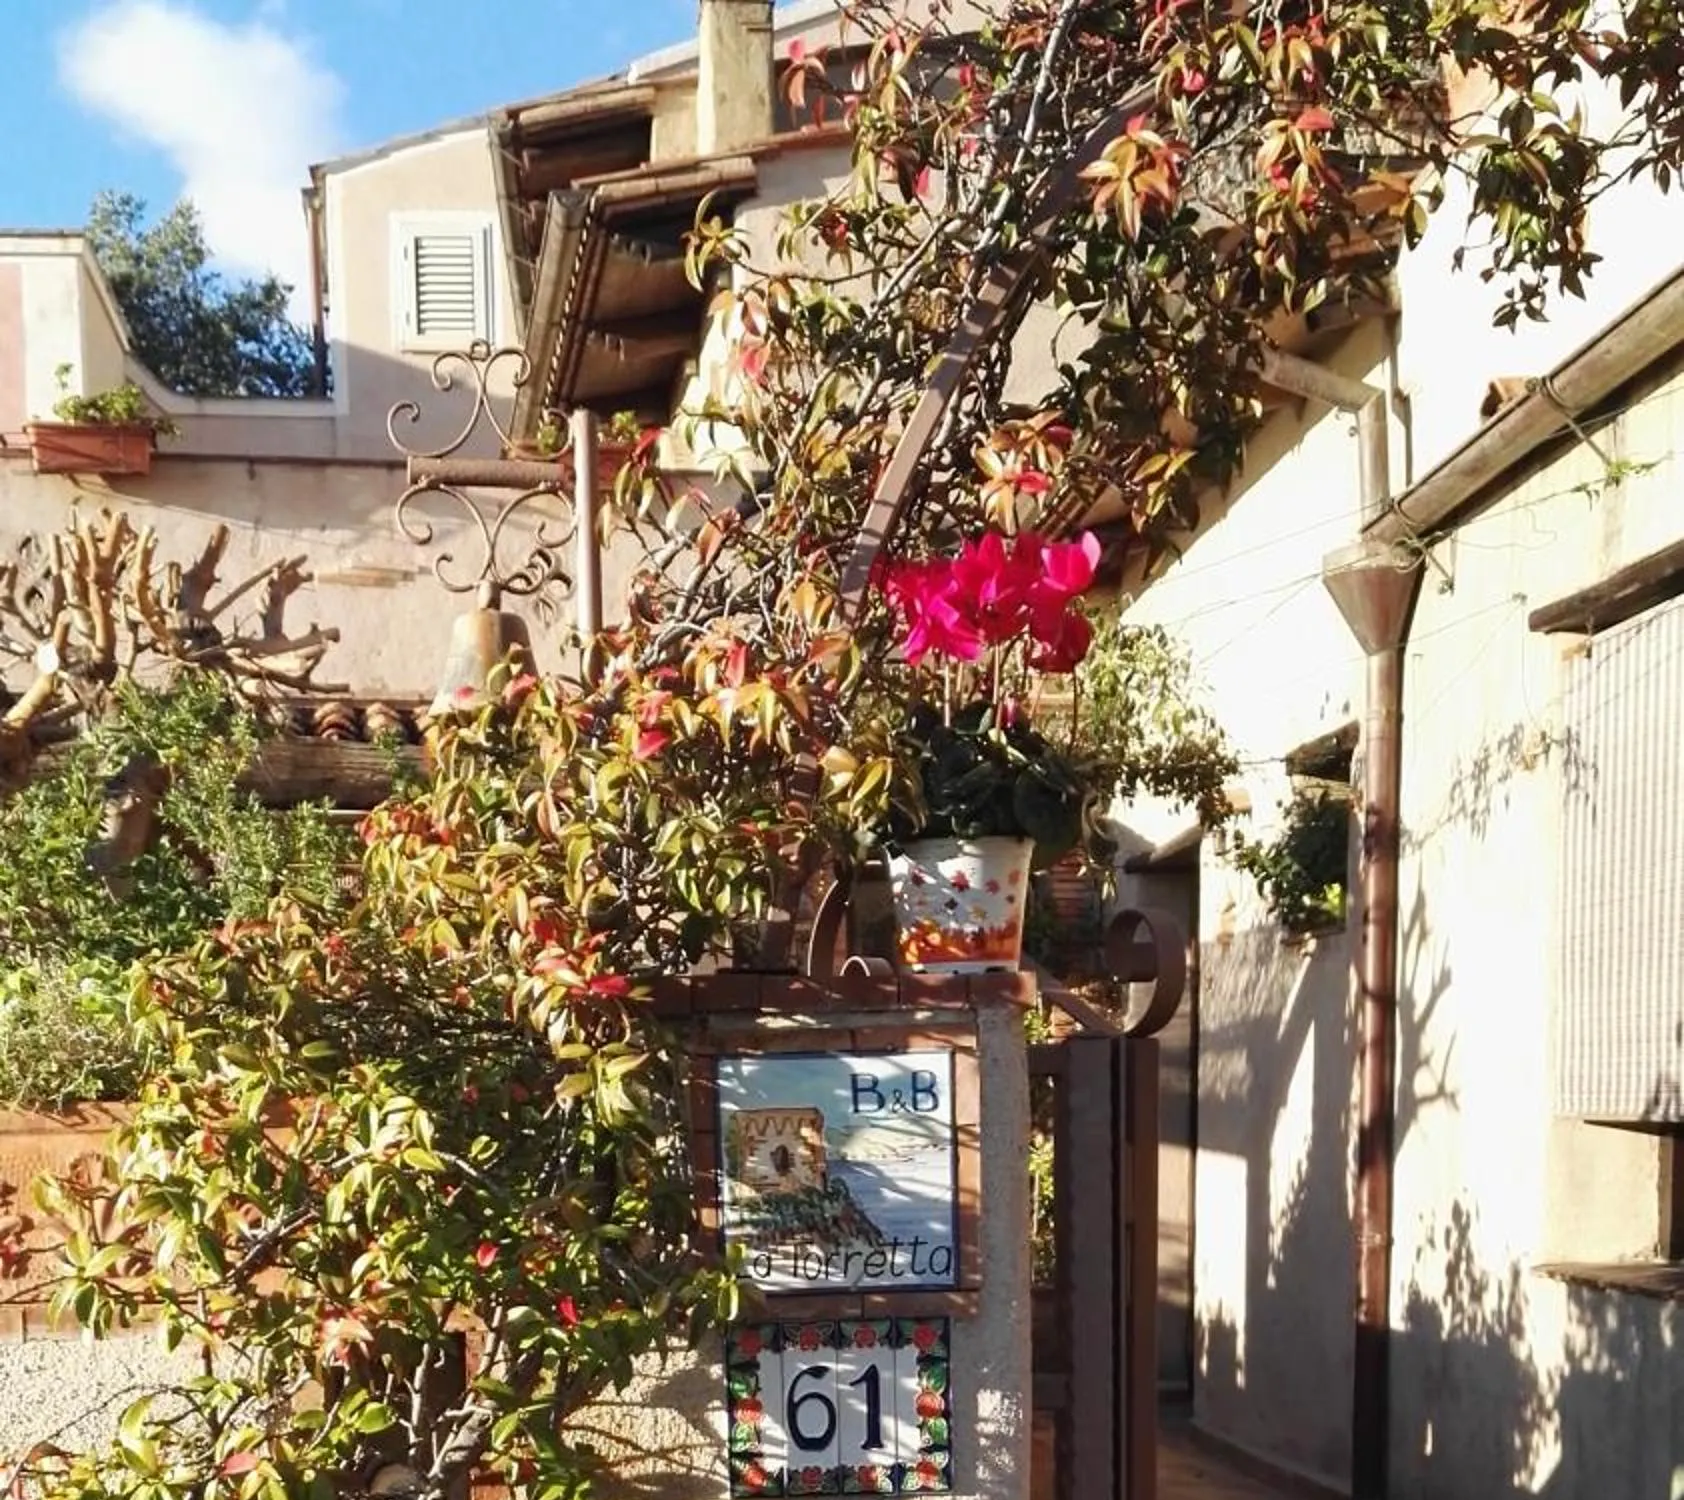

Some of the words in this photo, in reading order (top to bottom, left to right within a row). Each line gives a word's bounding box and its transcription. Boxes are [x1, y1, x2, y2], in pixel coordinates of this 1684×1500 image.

[849, 1069, 940, 1115] B&B
[791, 1233, 952, 1281] Torretta
[786, 1363, 885, 1452] 61
